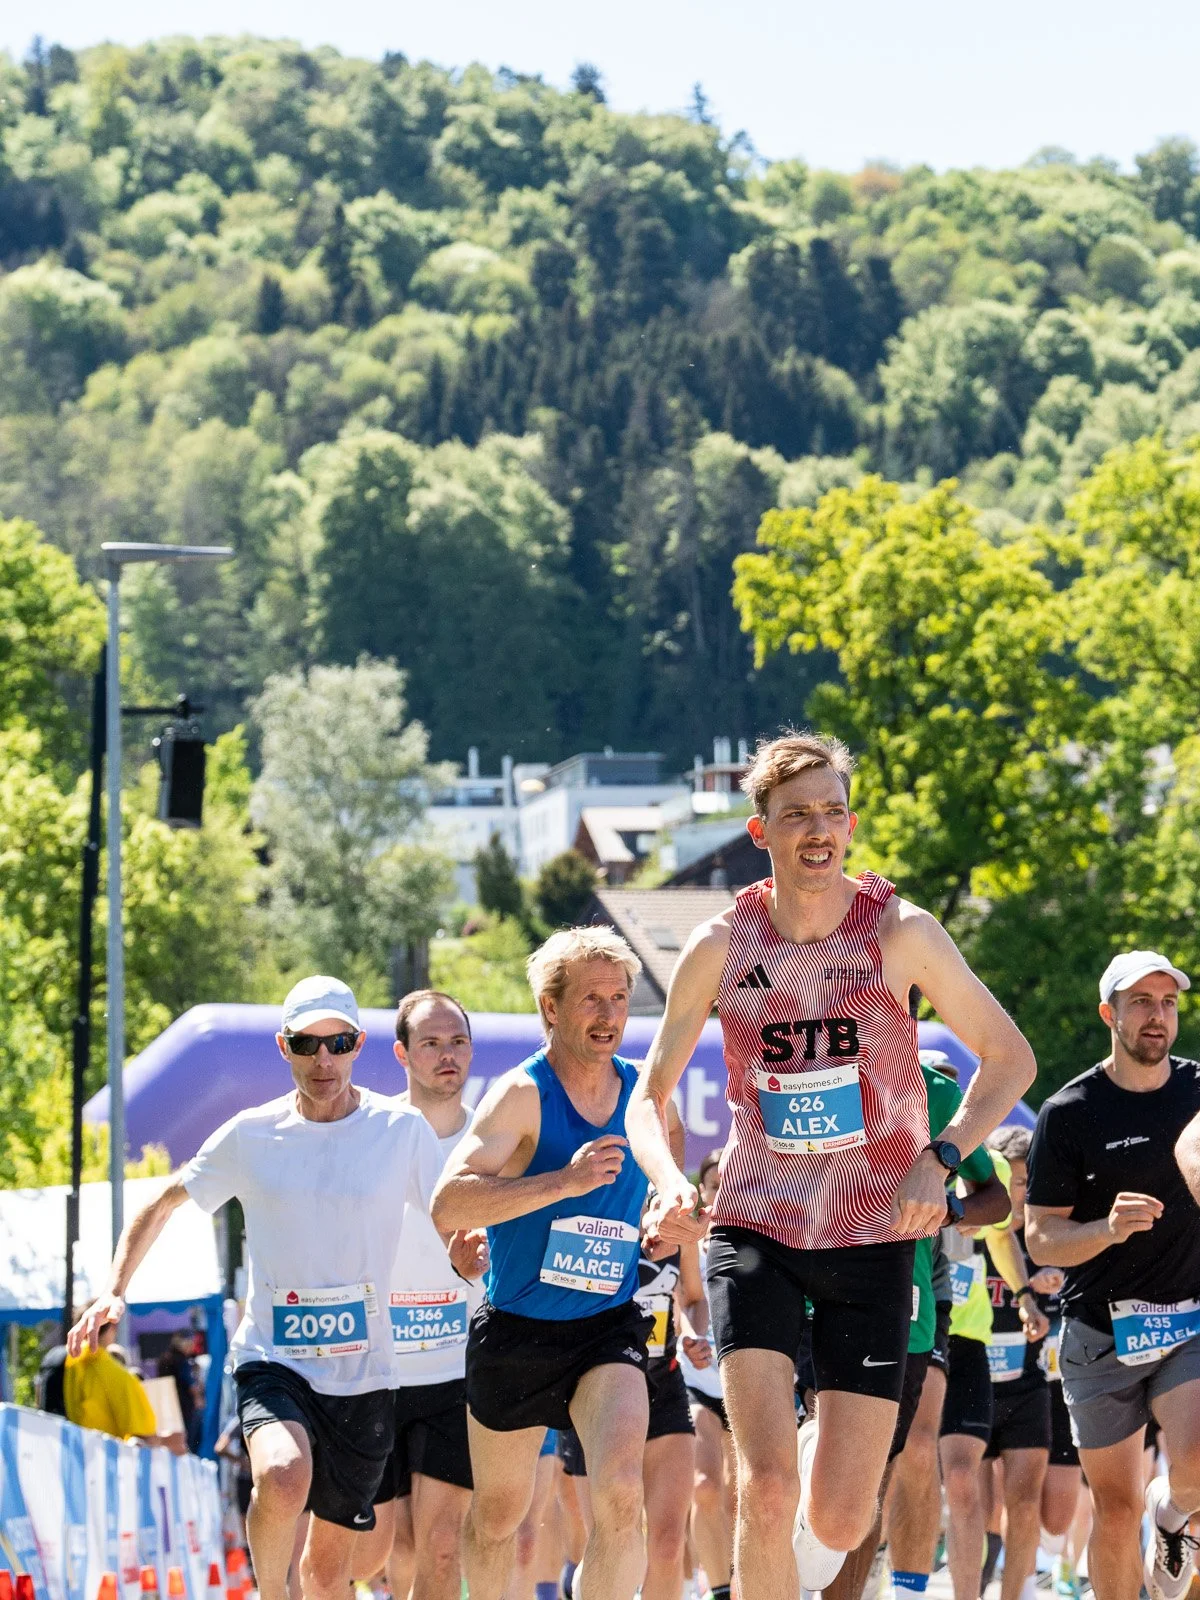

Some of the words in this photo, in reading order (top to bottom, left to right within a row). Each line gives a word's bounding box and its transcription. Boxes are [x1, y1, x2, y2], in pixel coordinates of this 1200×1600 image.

[761, 1018, 859, 1063] STB
[783, 1076, 843, 1091] easyhomes.ch
[789, 1096, 824, 1113] 626
[781, 1114, 840, 1135] ALEX
[577, 1221, 624, 1238] valiant
[584, 1239, 611, 1256] 765
[553, 1252, 624, 1278] MARCEL
[407, 1308, 444, 1322] 1366
[1143, 1317, 1171, 1329] 435
[284, 1312, 355, 1339] 2090
[1126, 1327, 1197, 1351] RAFAEL
